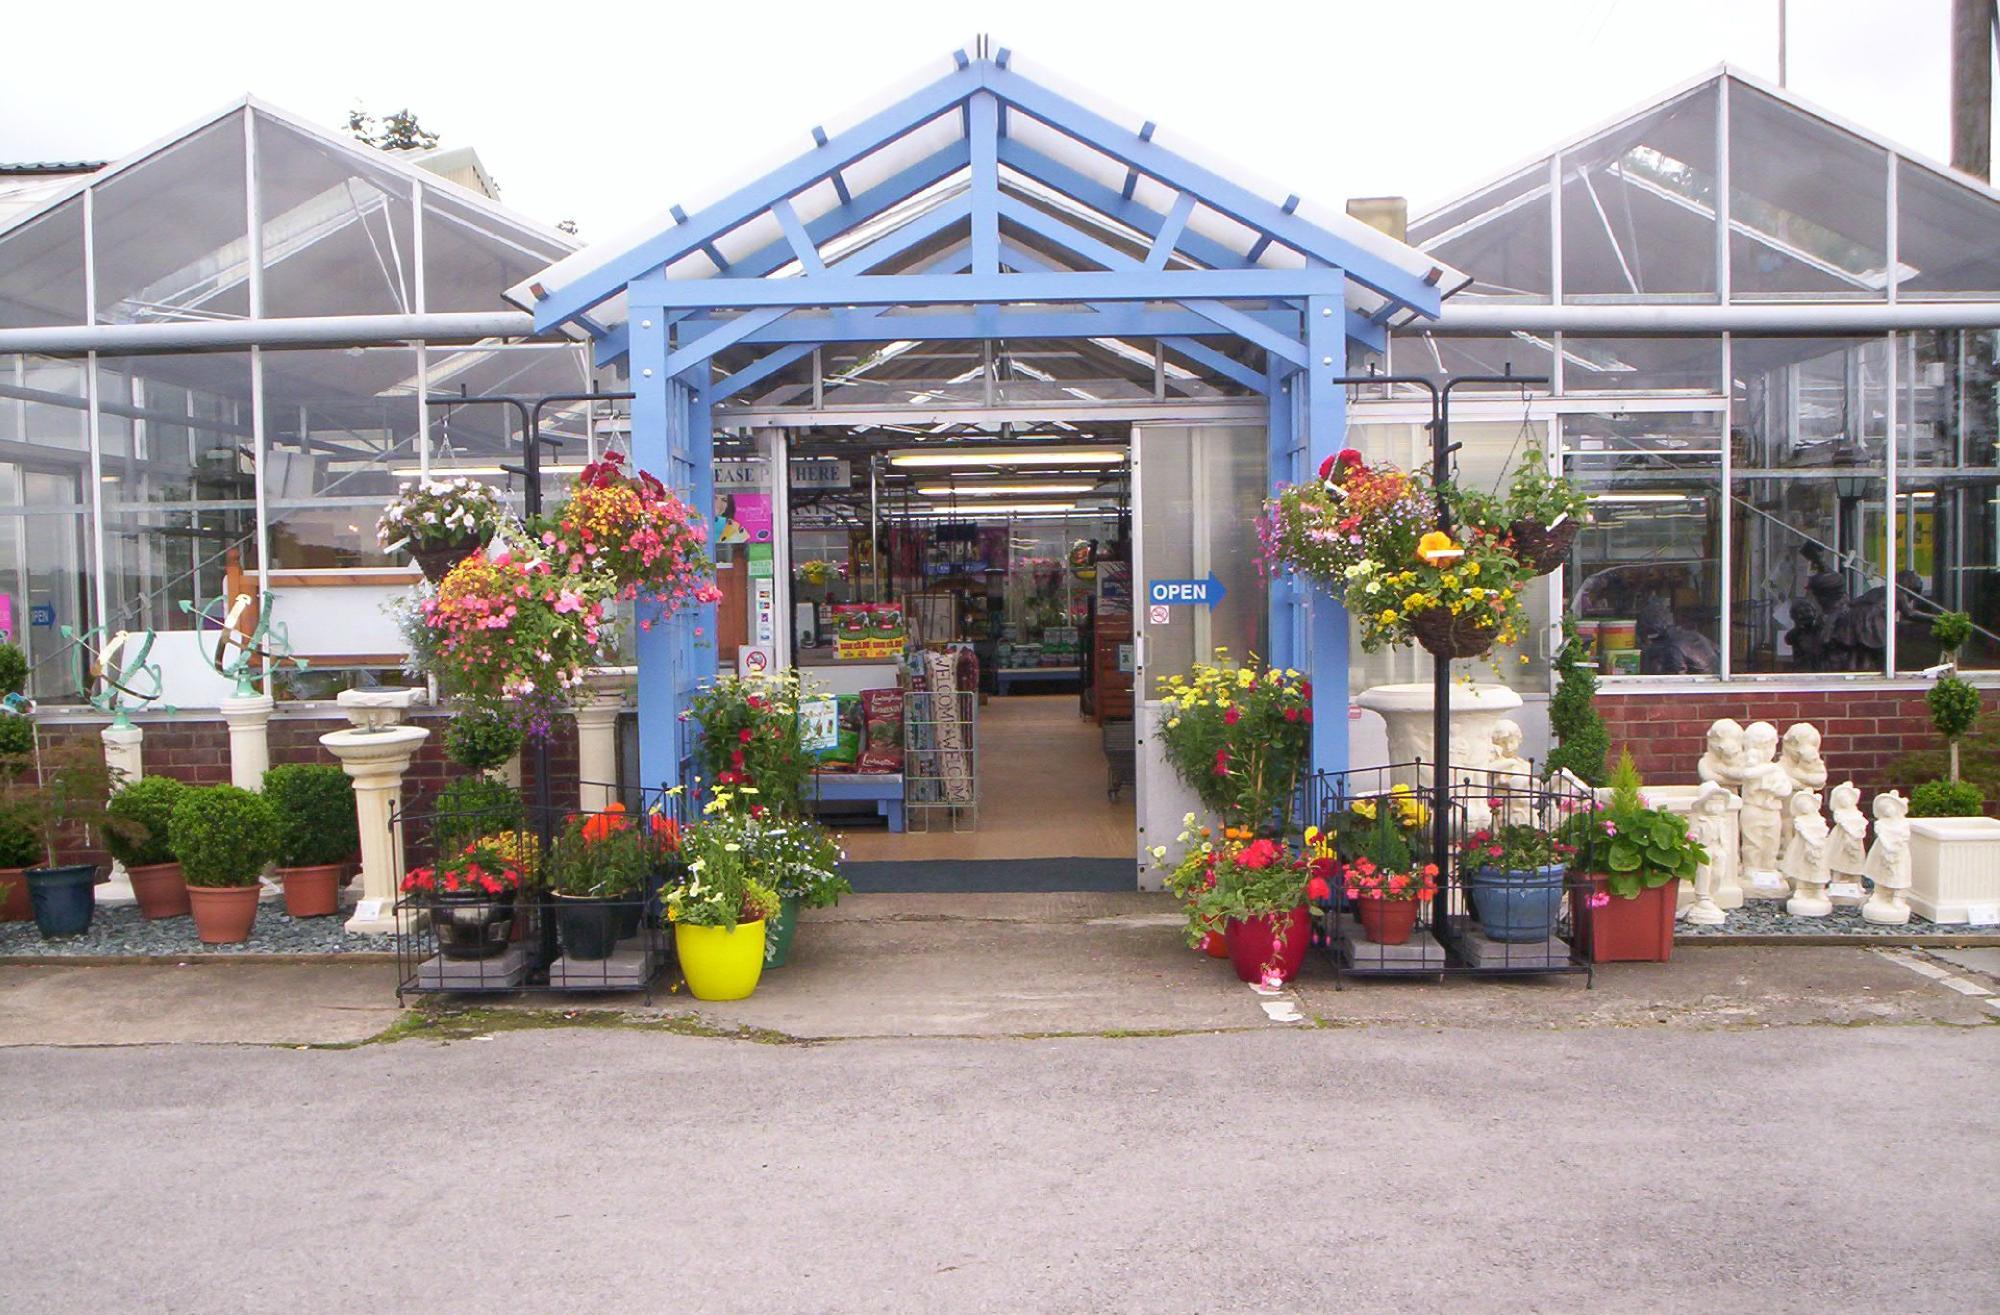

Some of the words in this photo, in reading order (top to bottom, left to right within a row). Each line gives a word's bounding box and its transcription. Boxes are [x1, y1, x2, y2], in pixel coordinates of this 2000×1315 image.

[715, 468, 754, 482] EASE
[795, 466, 840, 480] HERE
[1153, 584, 1206, 600] OPEN
[943, 736, 965, 800] WELCOM
